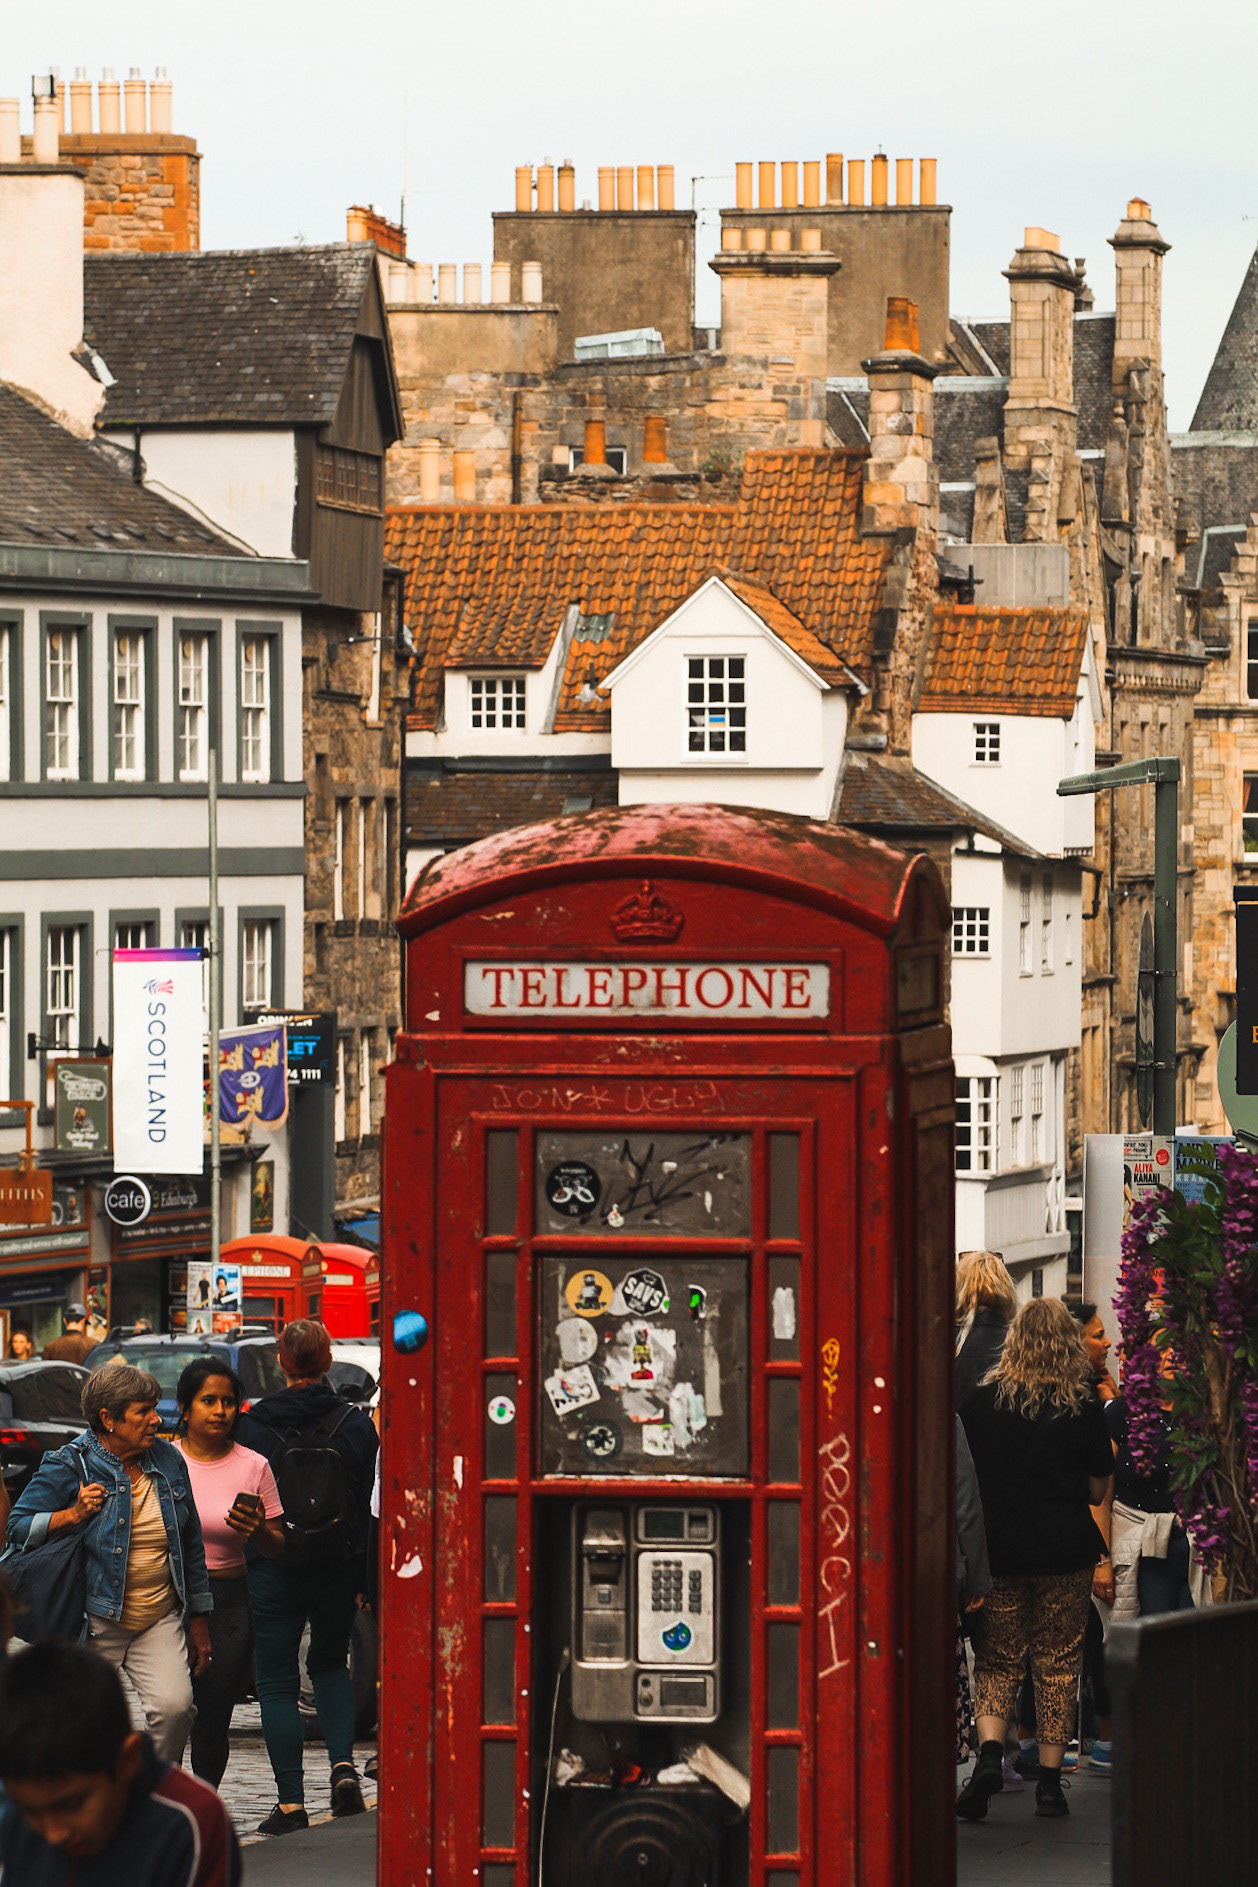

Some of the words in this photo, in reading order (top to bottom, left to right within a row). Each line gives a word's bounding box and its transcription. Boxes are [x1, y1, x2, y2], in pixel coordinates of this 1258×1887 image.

[481, 967, 813, 1010] TELEPHONE
[147, 1001, 167, 1144] SCOTLAND
[1133, 1173, 1160, 1184] KANANI
[1134, 1163, 1153, 1174] ALIYA
[108, 1190, 145, 1210] cafe
[160, 1189, 199, 1210] Edinburgh
